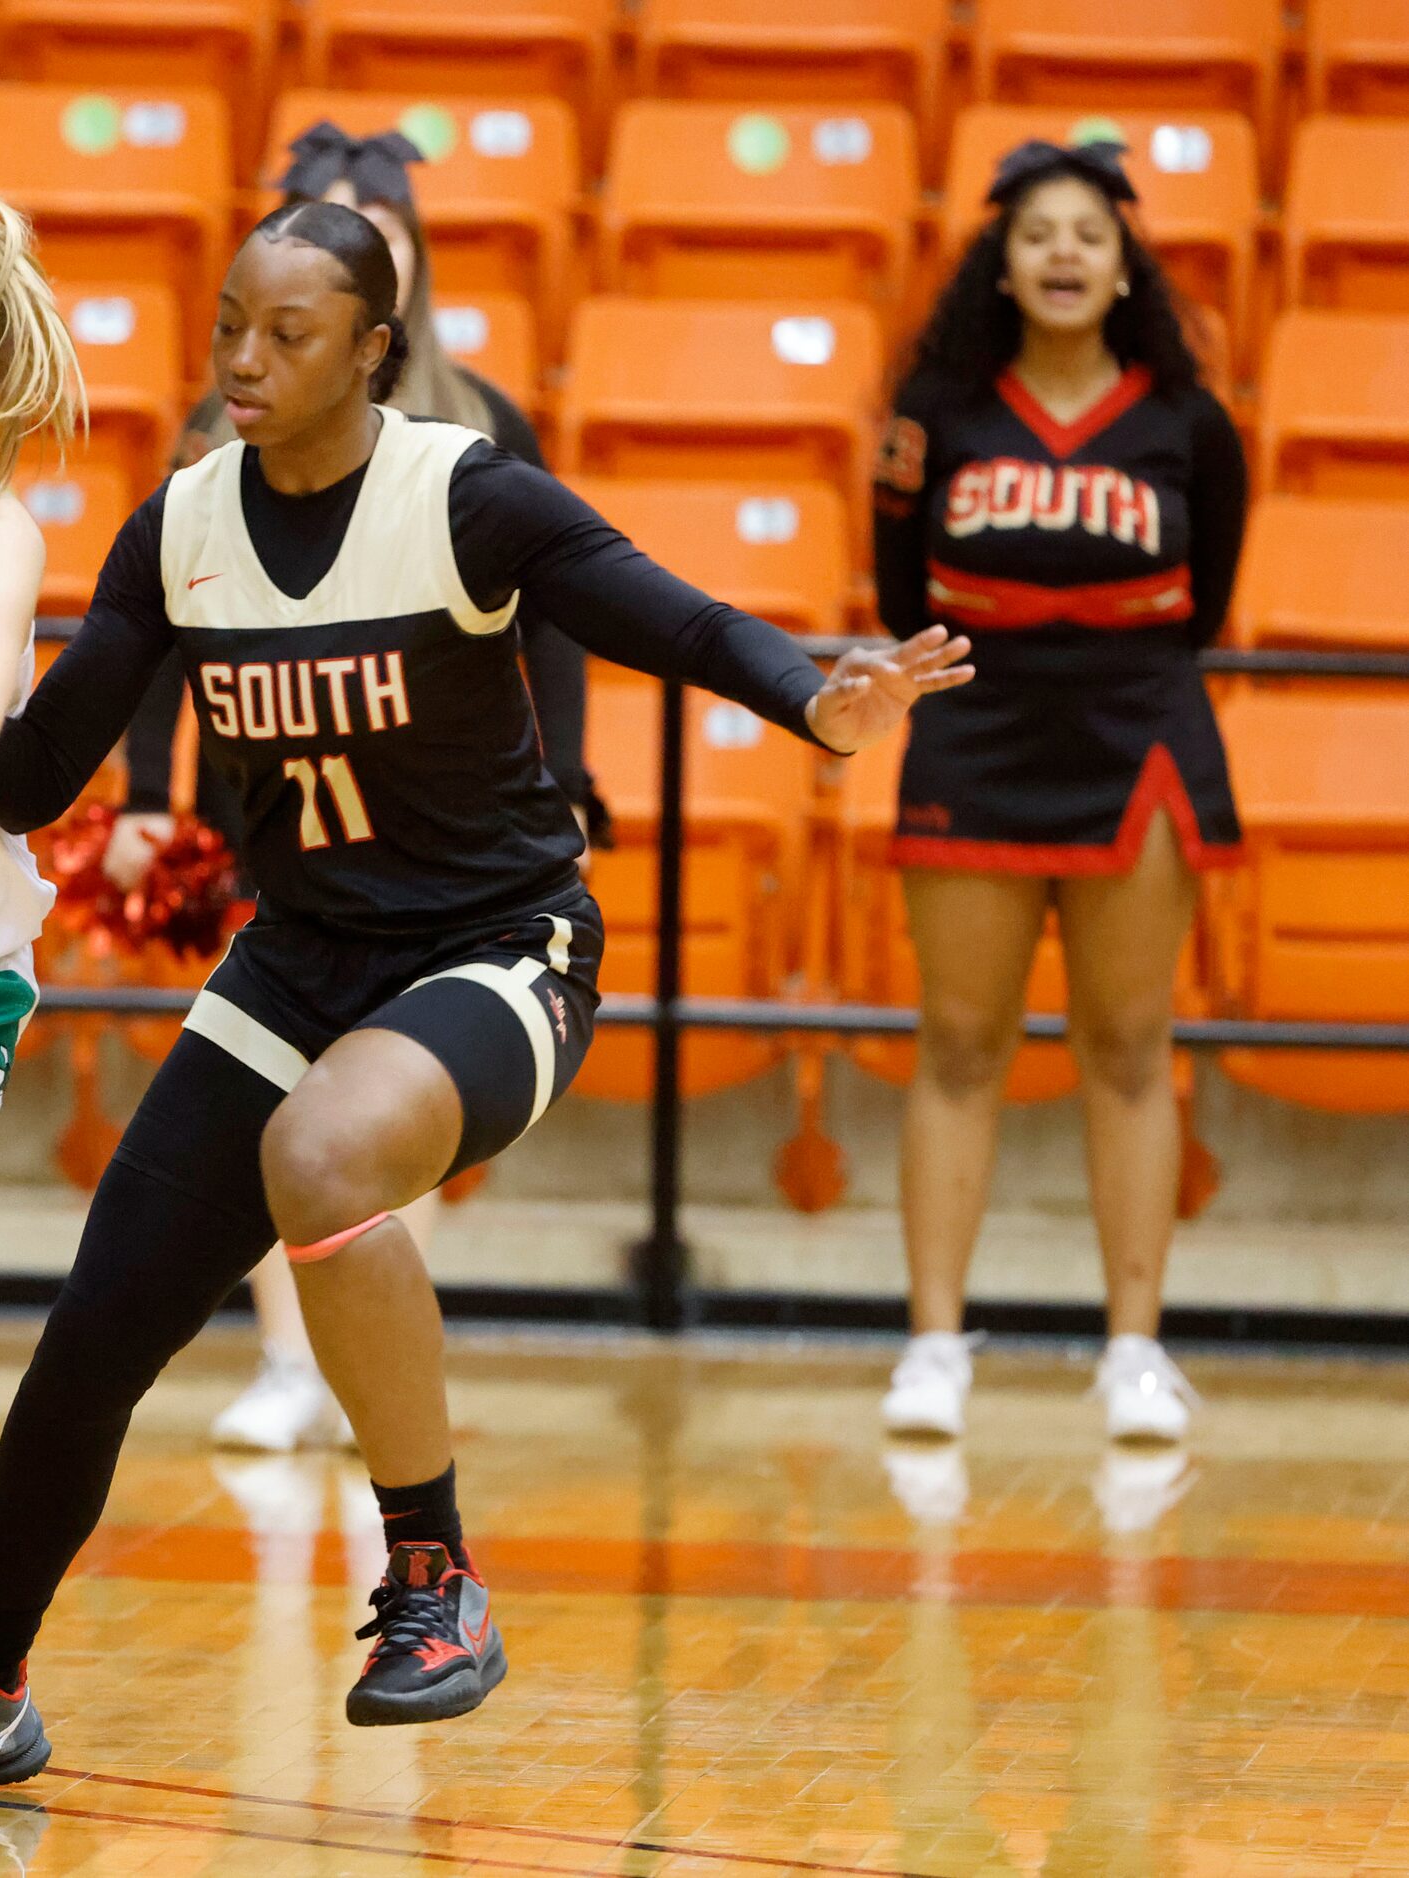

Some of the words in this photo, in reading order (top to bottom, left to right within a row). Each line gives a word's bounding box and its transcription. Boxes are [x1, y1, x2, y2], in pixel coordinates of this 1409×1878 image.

[943, 455, 1162, 557] SOUTH
[199, 651, 412, 740] SOUTH
[282, 754, 375, 852] 11
